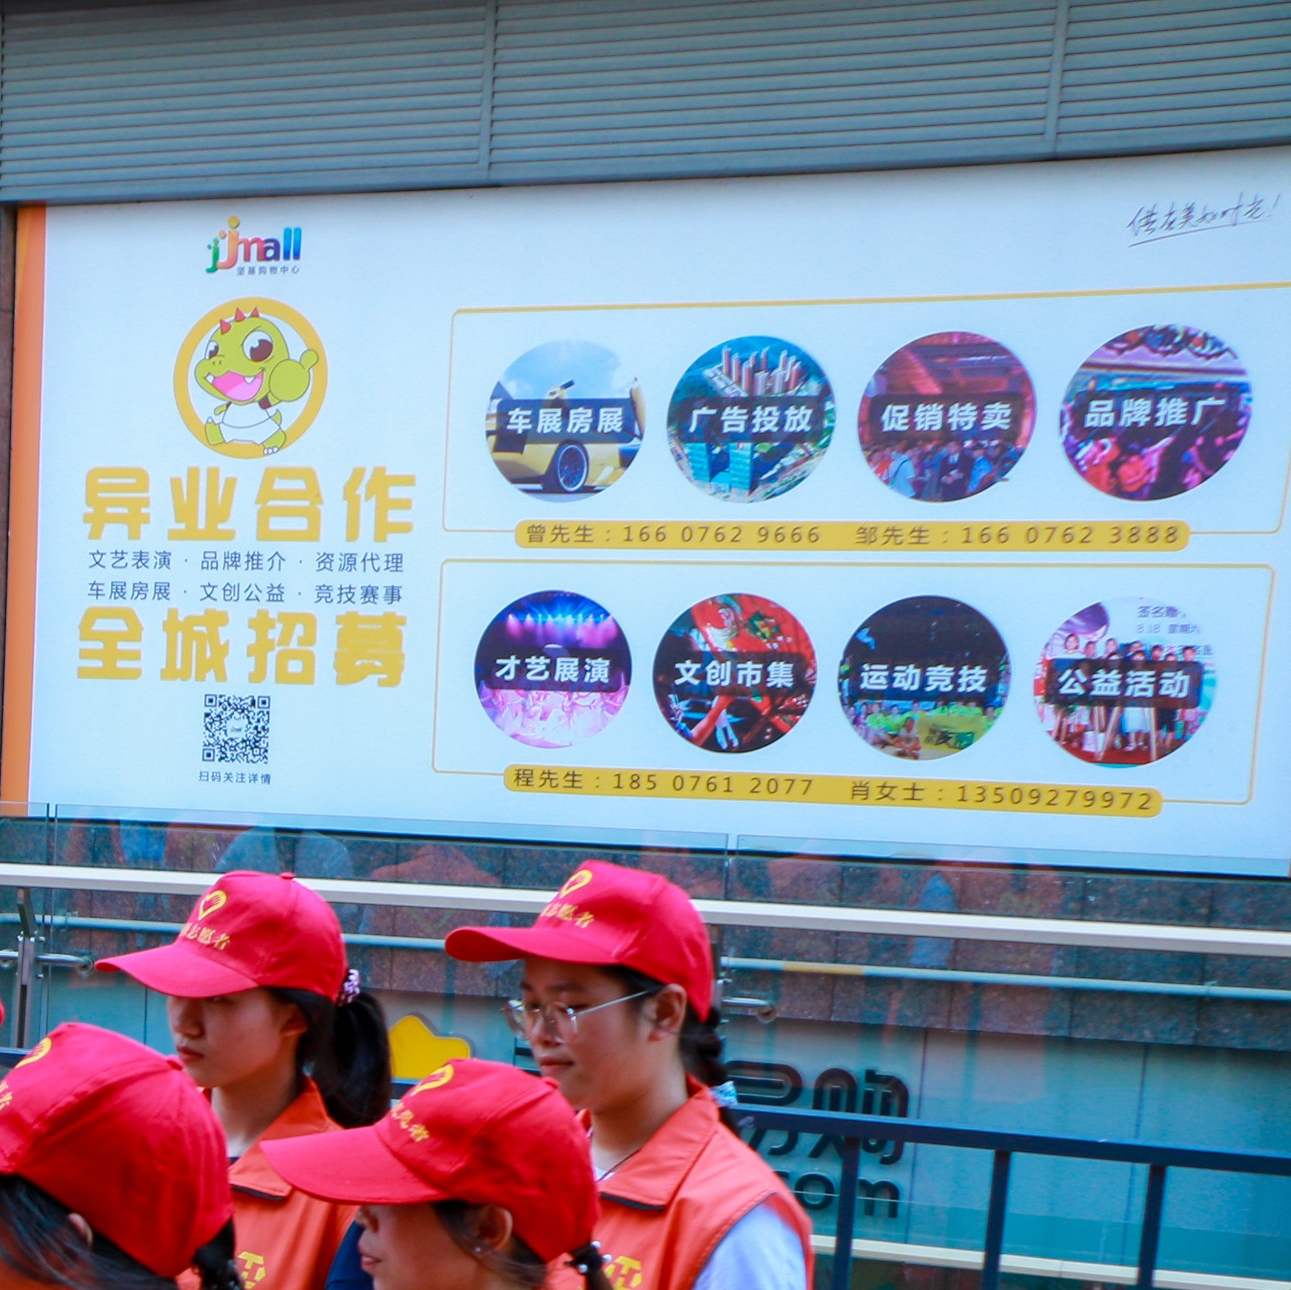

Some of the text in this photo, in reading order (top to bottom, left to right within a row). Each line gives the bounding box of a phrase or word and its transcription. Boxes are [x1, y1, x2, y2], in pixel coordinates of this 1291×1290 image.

[236, 264, 300, 276] 坚基购物中心
[506, 406, 625, 435] 车展房展
[688, 405, 813, 434] 广告投放
[881, 401, 1012, 433] 促销特卖
[1083, 397, 1225, 428] 品牌推广
[82, 466, 416, 543] 异业合作
[623, 525, 667, 544] 166
[681, 526, 743, 544] 0762
[756, 526, 821, 544] 9666
[962, 526, 1010, 545] 166
[1025, 526, 1094, 544] 0762
[1108, 526, 1180, 545] 3888
[88, 550, 405, 574] 文艺表演 品牌推介 资源代理
[87, 580, 403, 605] 车展房展 文创公益 竞技赛事
[76, 606, 408, 688] 全城招募
[495, 655, 611, 684] 才艺展演
[673, 658, 795, 689] 文创市集
[859, 662, 988, 694] 运动竞技
[1057, 667, 1190, 699] 公益活动
[198, 770, 272, 785] 扫码关注详情
[613, 772, 658, 790] 185
[672, 774, 735, 793] 0761
[749, 777, 814, 796] 2077
[957, 783, 1153, 811] 13509279972
